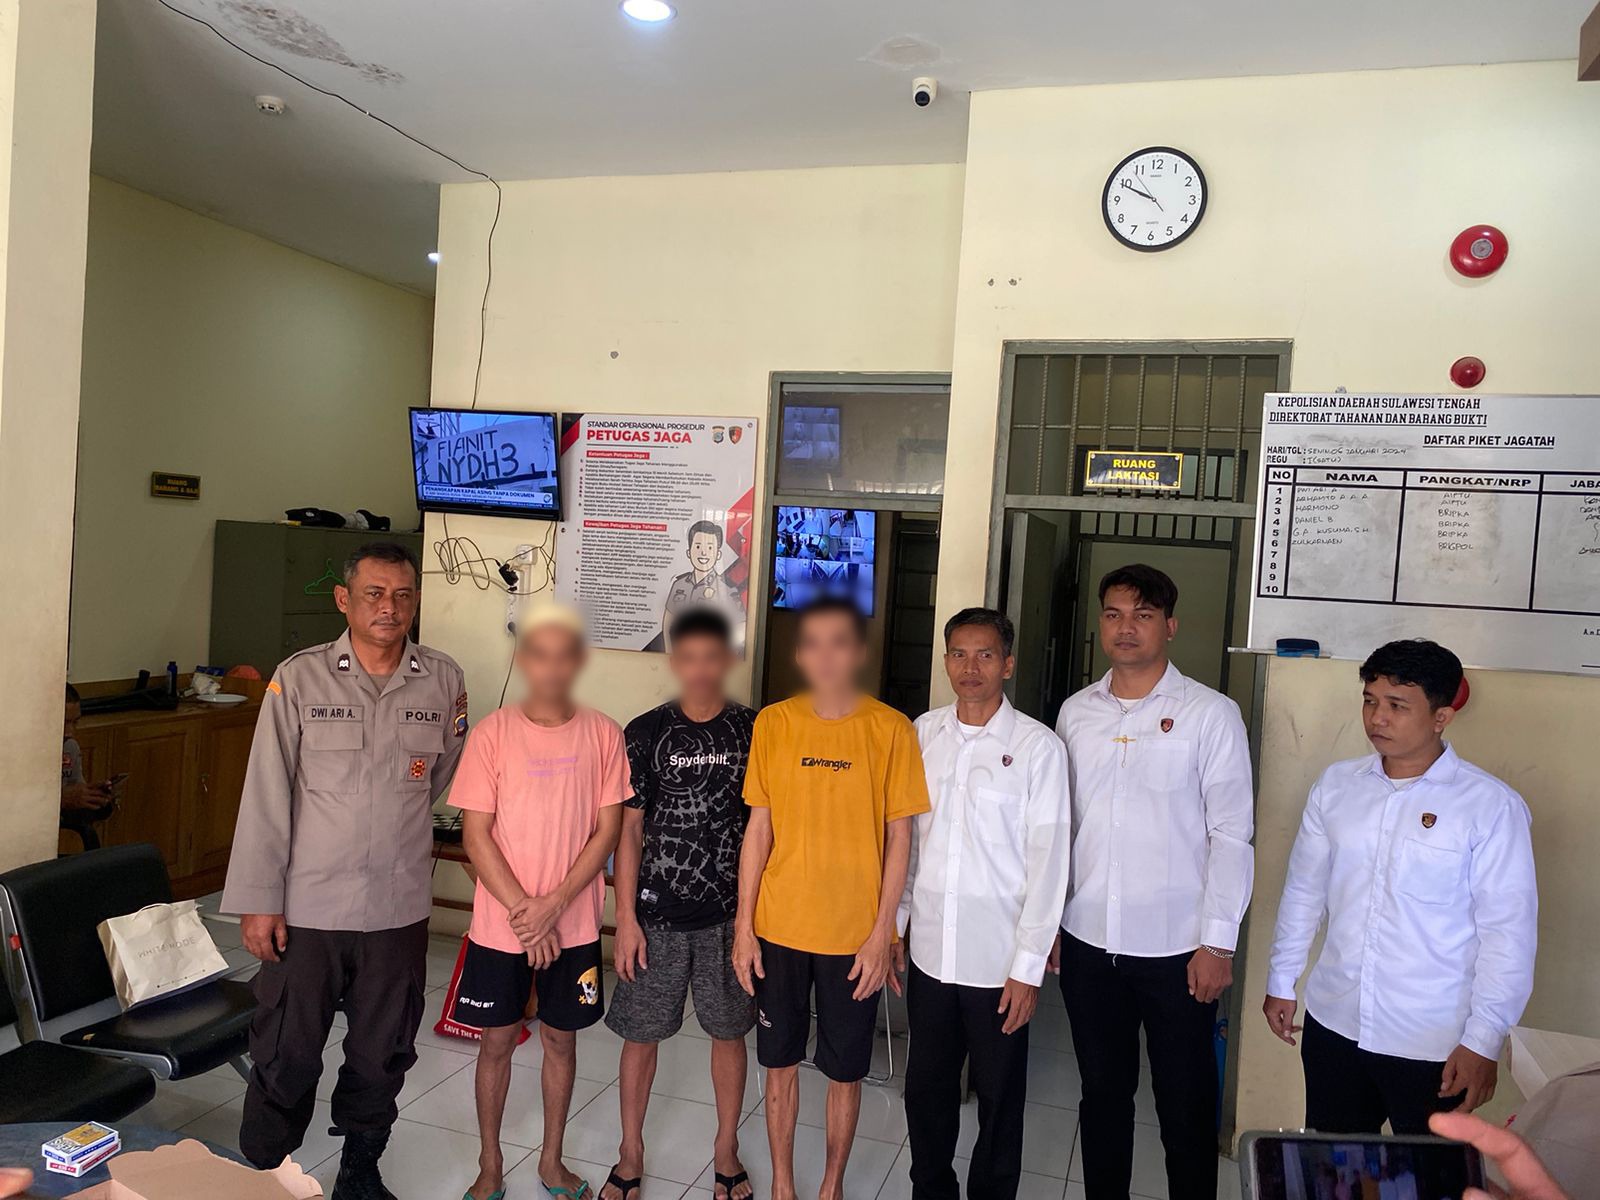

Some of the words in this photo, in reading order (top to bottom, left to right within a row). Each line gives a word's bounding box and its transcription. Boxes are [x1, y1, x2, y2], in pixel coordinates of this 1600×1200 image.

[1135, 164, 1145, 175] 11
[1152, 159, 1164, 170] 12
[1120, 178, 1132, 189] 10
[1185, 176, 1192, 187] 2
[1114, 195, 1121, 205] 9
[1188, 195, 1196, 205] 3
[1117, 213, 1124, 223] 8
[1180, 214, 1188, 223] 4
[1130, 225, 1138, 235] 7
[1166, 226, 1173, 236] 5
[1147, 231, 1154, 240] 6
[1277, 397, 1338, 408] KEPOLISIAN
[1339, 398, 1380, 408] DAERAH
[1381, 398, 1435, 409] SULAWESI
[1437, 398, 1481, 409] TENGAH
[1269, 412, 1333, 423] DIREKTORAT
[1334, 412, 1383, 424] TAHANAN
[1385, 413, 1406, 424] DAN
[1408, 414, 1452, 425] BARANG
[1453, 414, 1488, 425] BUKTI
[587, 421, 618, 429] STANDAR
[619, 422, 666, 430] OPERASIONAL
[667, 423, 705, 431] PROSEDUR
[587, 430, 650, 442] PETUGAS
[653, 431, 692, 443] JAGA
[1424, 435, 1465, 446] DAFTAR
[1468, 435, 1502, 446] PIKET
[1504, 436, 1555, 447] JAGATAH
[1113, 459, 1156, 469] RUANG
[1107, 470, 1159, 481] LAKTASI
[1272, 471, 1291, 479] NO
[1326, 473, 1378, 482] NAMA
[1419, 475, 1532, 487] PANGKAT/NRP
[493, 489, 509, 497] TANPA
[1274, 507, 1281, 515] 3
[1273, 518, 1280, 526] 4
[1272, 529, 1279, 537] 5
[1270, 550, 1278, 558] 7
[1270, 562, 1277, 570] 8
[1269, 573, 1276, 581] 9
[311, 708, 328, 718] DWI
[330, 708, 345, 718] ARI
[347, 709, 356, 718] A.
[405, 711, 441, 723] POLRI
[814, 758, 852, 772] Wrangler
[443, 1023, 460, 1035] SAVE
[460, 1029, 473, 1039] THE
